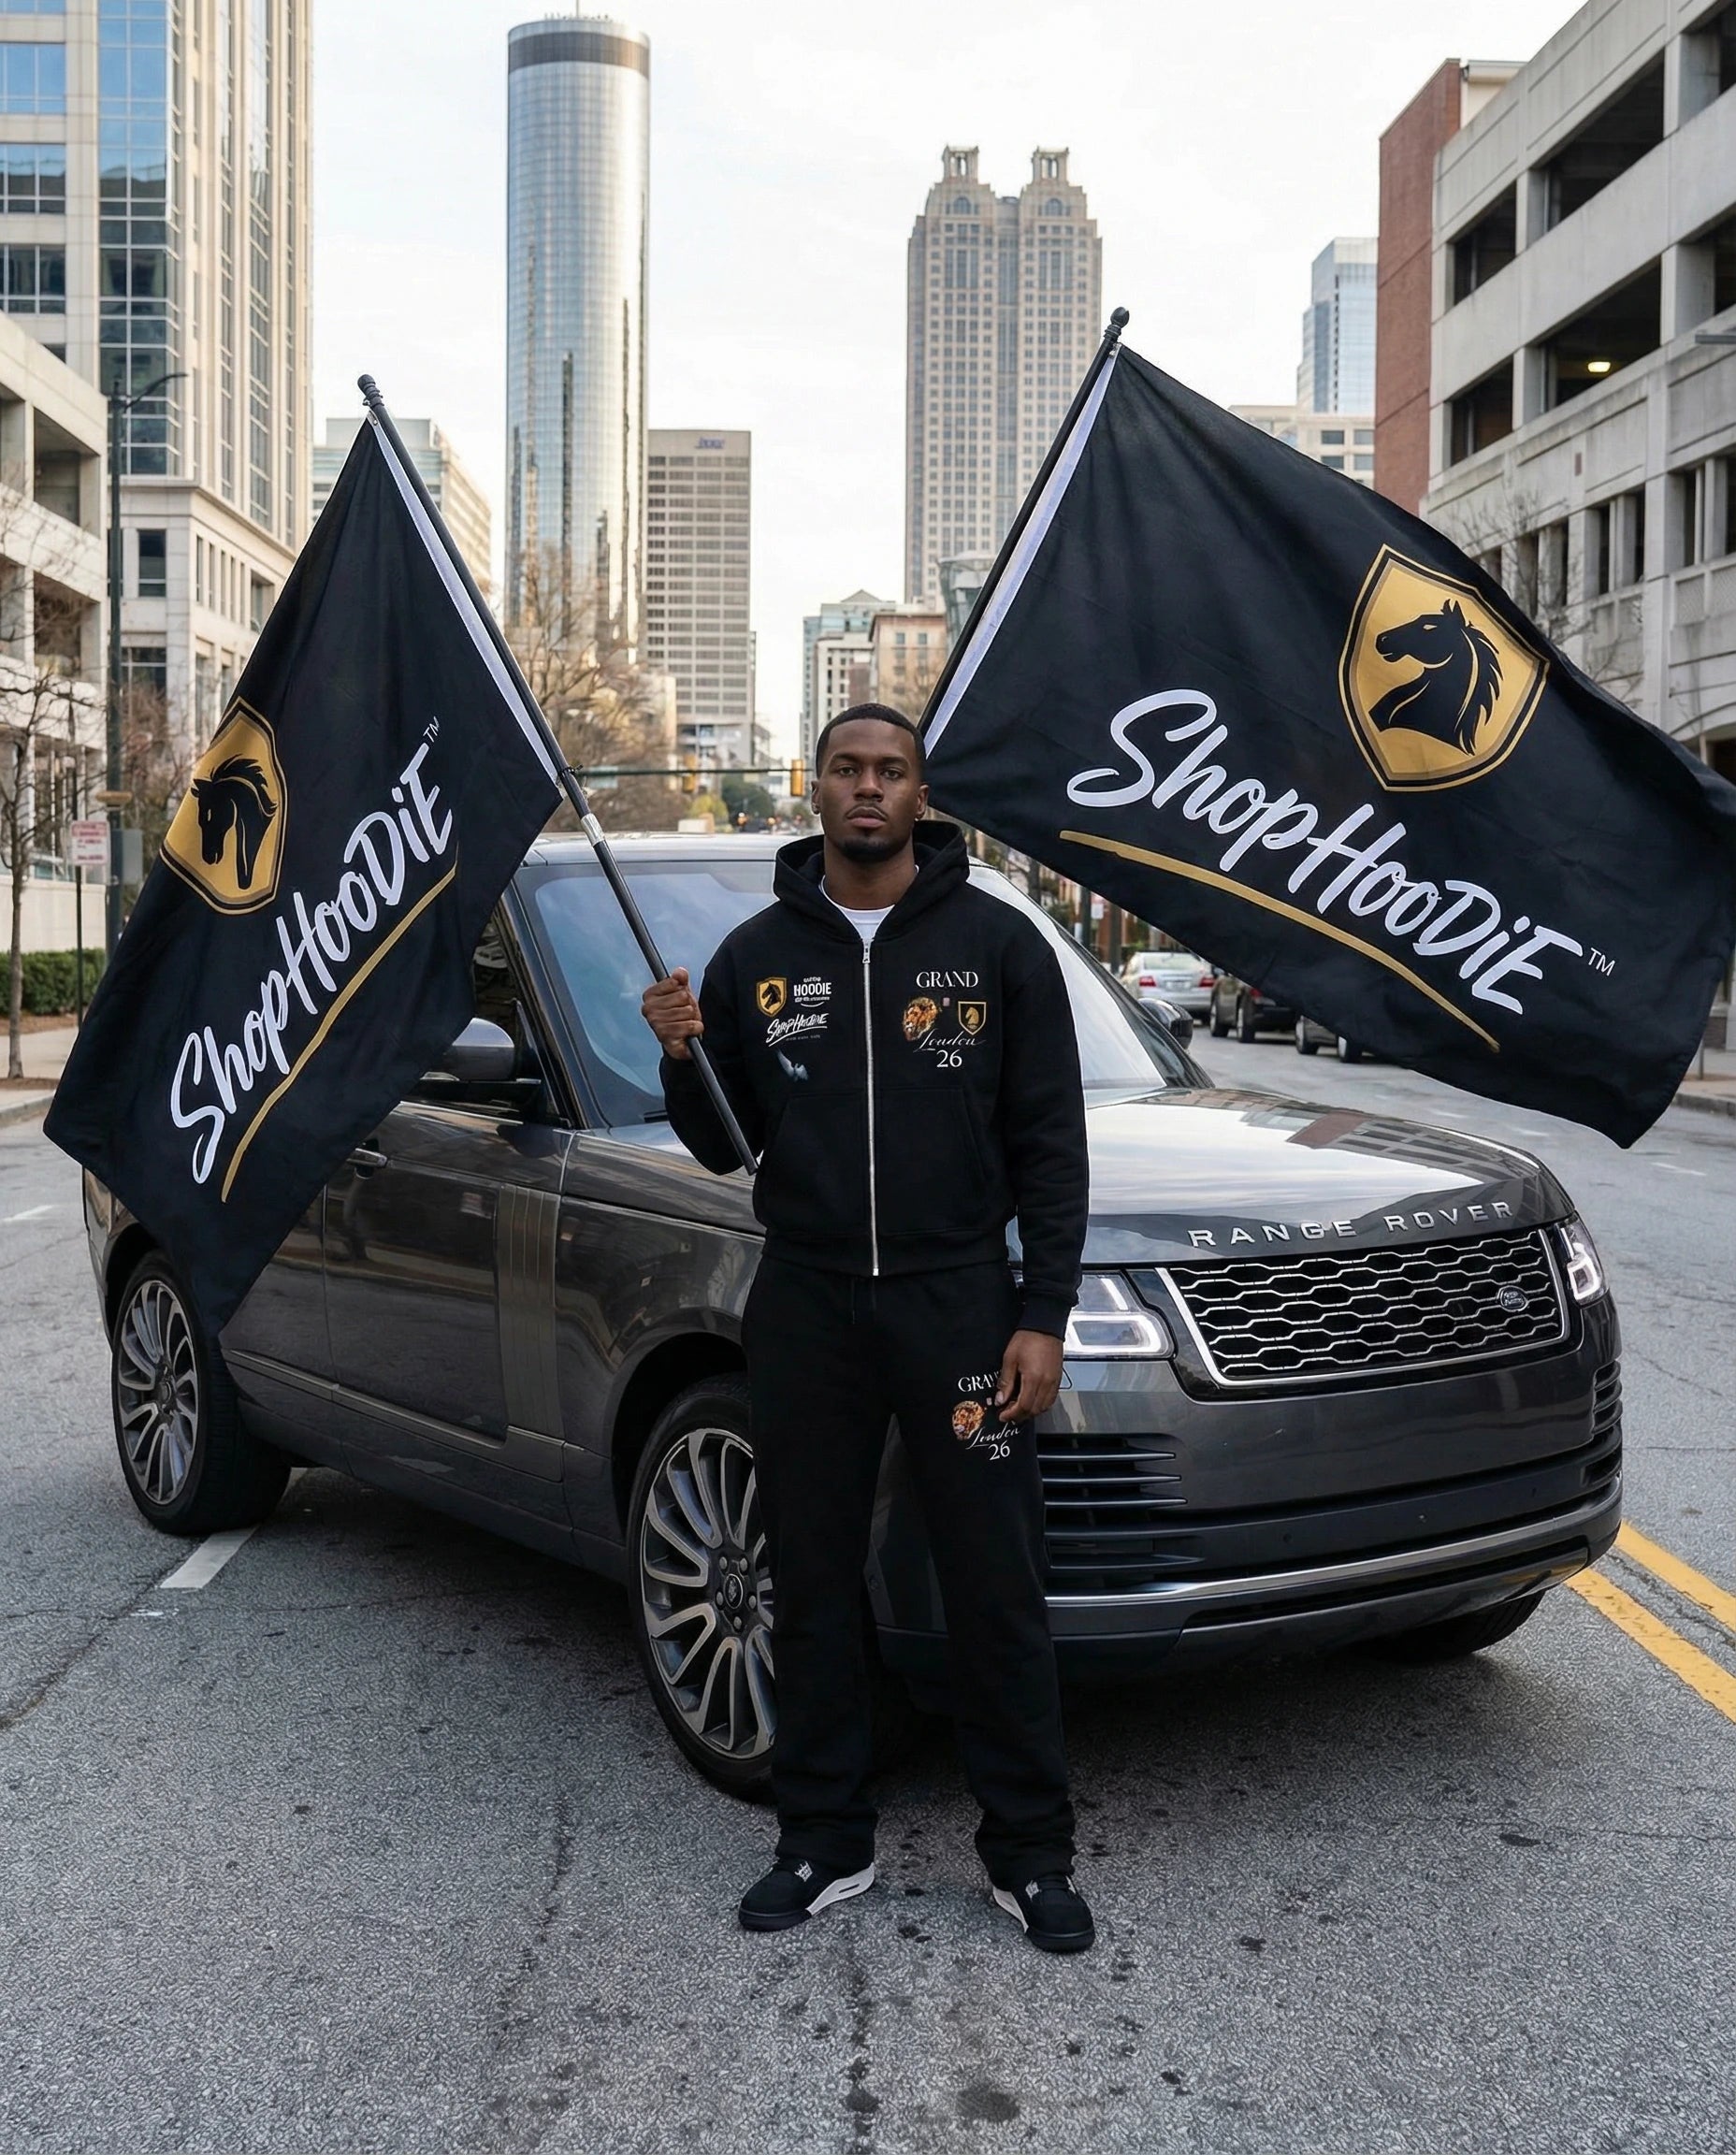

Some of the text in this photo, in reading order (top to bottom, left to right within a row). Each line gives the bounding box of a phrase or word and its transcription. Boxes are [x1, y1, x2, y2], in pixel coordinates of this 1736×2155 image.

[916, 971, 979, 989] GRAND
[936, 1049, 962, 1068] 26
[1187, 1201, 1513, 1248] RANGE ROVER
[958, 1370, 1000, 1393] GRA
[988, 1440, 1011, 1461] 26
